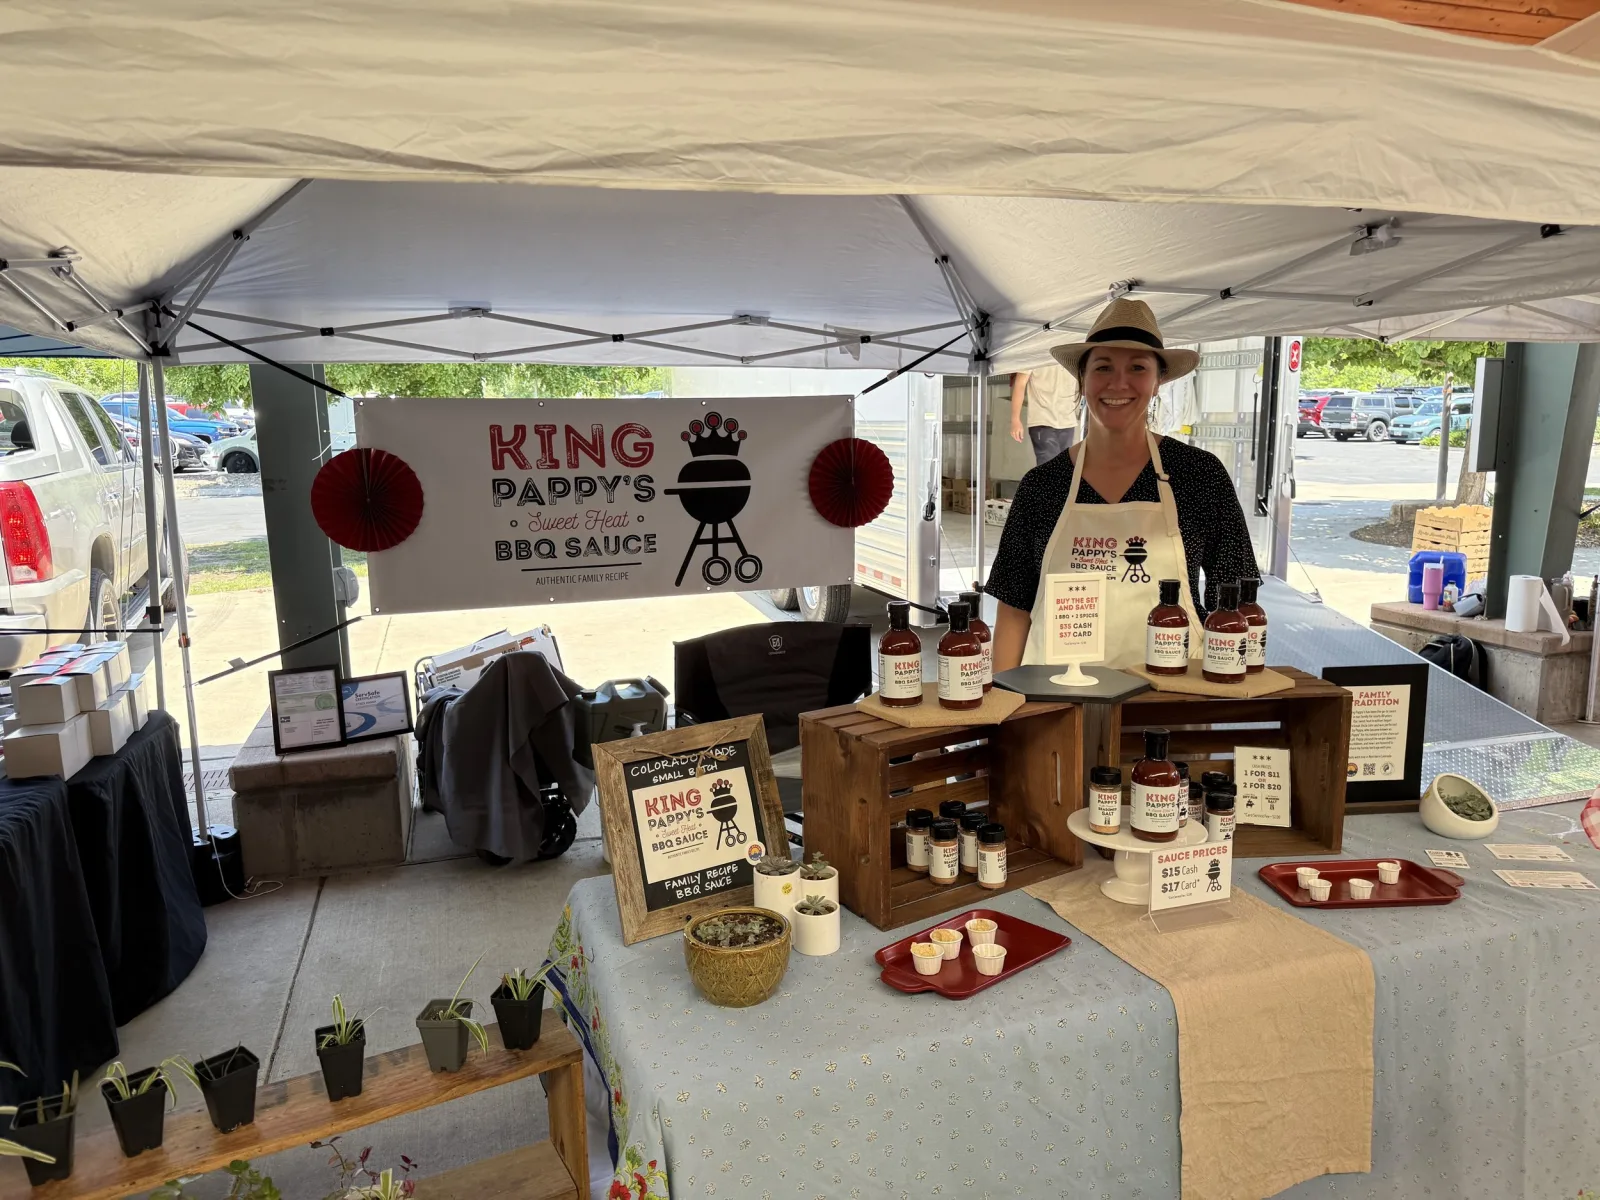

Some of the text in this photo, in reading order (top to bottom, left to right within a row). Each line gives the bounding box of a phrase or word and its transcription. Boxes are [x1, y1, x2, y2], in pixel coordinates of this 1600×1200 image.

[489, 422, 655, 470] KING
[491, 474, 656, 507] PAPPY'S
[527, 509, 630, 533] Sweet Heat
[494, 533, 657, 561] BBQ SAUCE
[1072, 536, 1118, 549] KING
[1071, 548, 1117, 559] PAPPY'S
[1070, 562, 1117, 572] BBQ SAUCE
[535, 571, 629, 586] AUTHENTIC FAMILY RECIPE
[1075, 603, 1096, 611] SAVE!
[1155, 632, 1181, 641] KING
[1208, 637, 1235, 647] KING
[894, 660, 920, 670] KING
[1359, 691, 1392, 699] FAMILY
[630, 753, 698, 777] COLORADO
[652, 761, 718, 784] SMALL BTCH
[644, 788, 702, 817] KING
[1145, 792, 1176, 802] KING
[647, 807, 705, 831] PAPPY'S
[660, 823, 697, 839] Sweet Heat
[651, 830, 709, 852] BBQ SAUCE
[1157, 845, 1228, 864] SAUCE PRICES
[664, 863, 739, 891] FAMILY RECIPE
[1161, 864, 1198, 879] $15 Cash
[676, 875, 733, 899] BBQ SAUCE
[1161, 881, 1180, 894] $17
